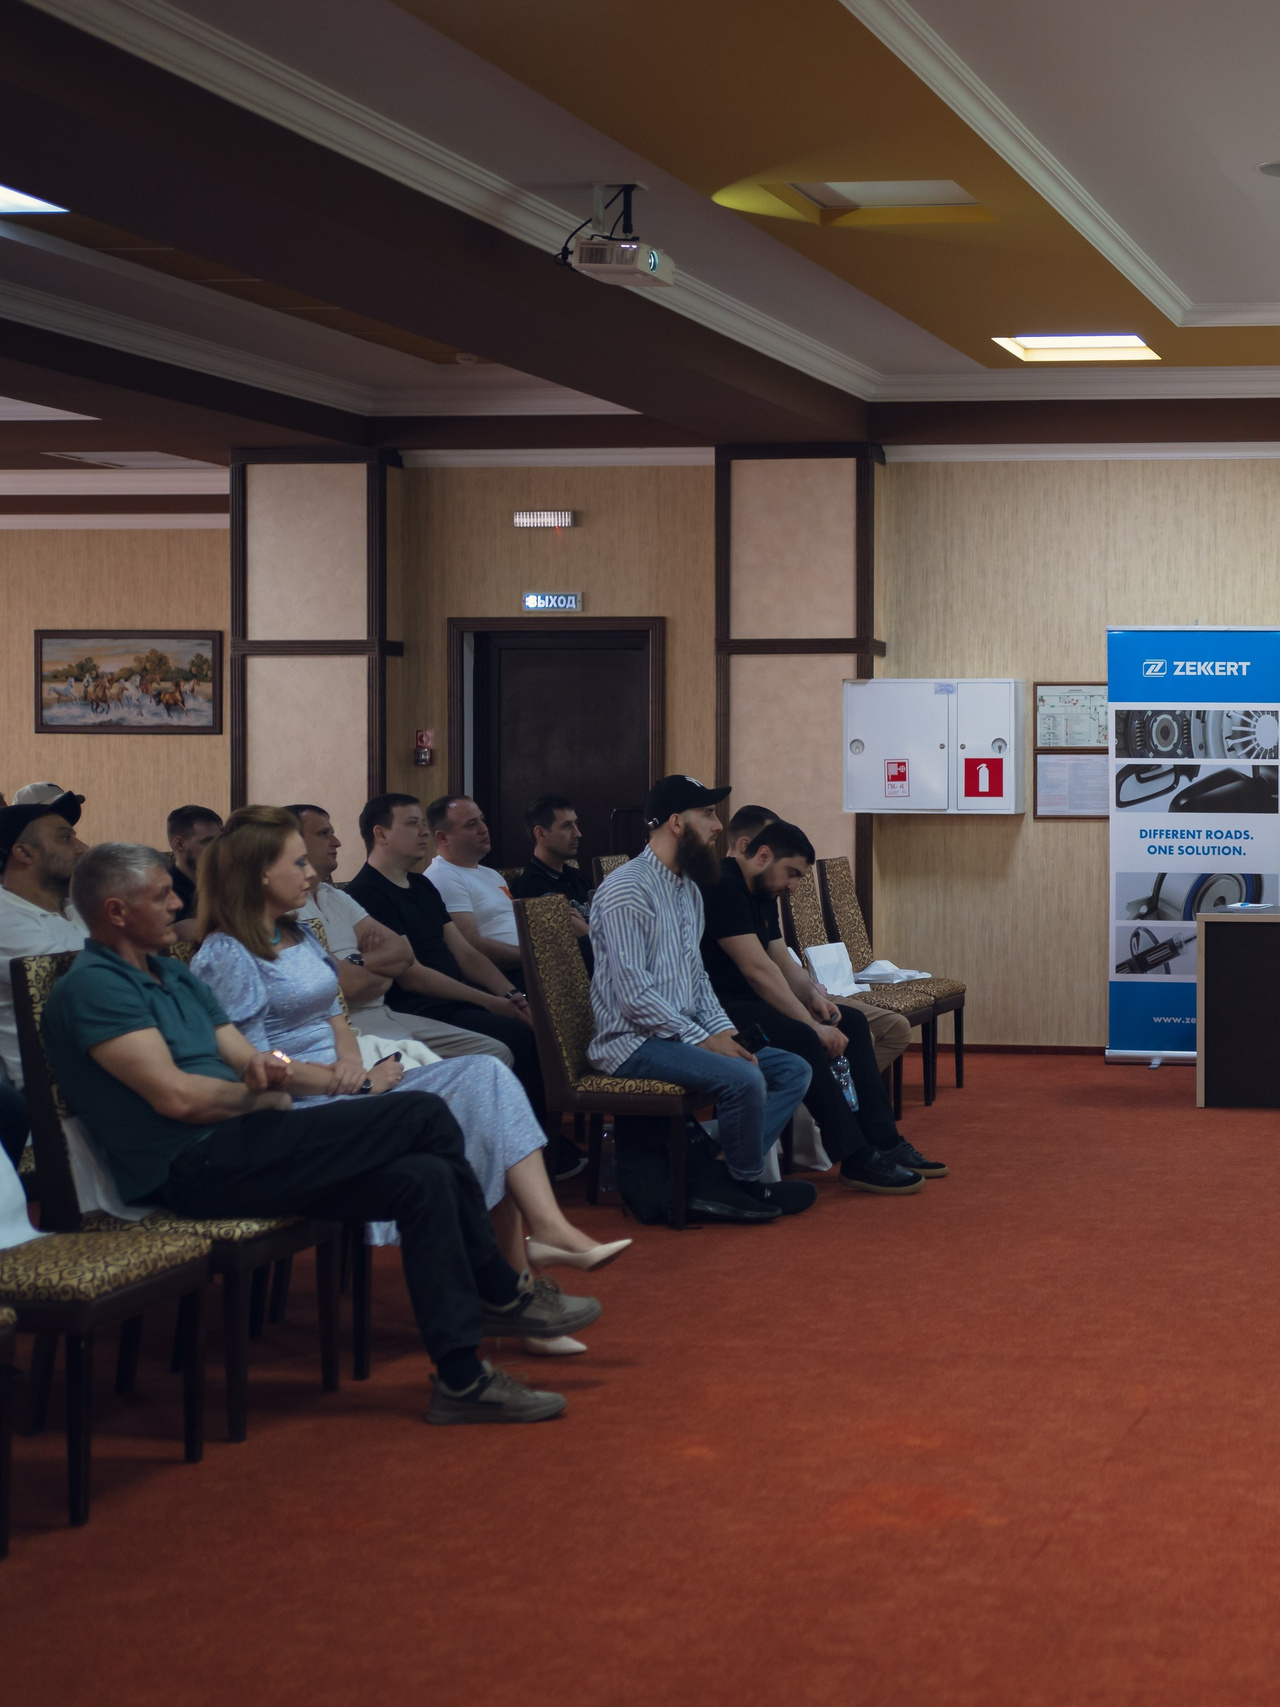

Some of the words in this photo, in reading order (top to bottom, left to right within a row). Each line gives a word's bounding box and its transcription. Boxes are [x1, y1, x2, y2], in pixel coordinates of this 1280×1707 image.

[526, 595, 576, 609] ВЫХОД
[1173, 661, 1251, 676] ZEKKERT
[1139, 829, 1203, 840] DIFFERENT
[1205, 829, 1254, 840] ROADS.
[1147, 845, 1174, 855] ONE
[1177, 845, 1247, 856] SOLUTION.
